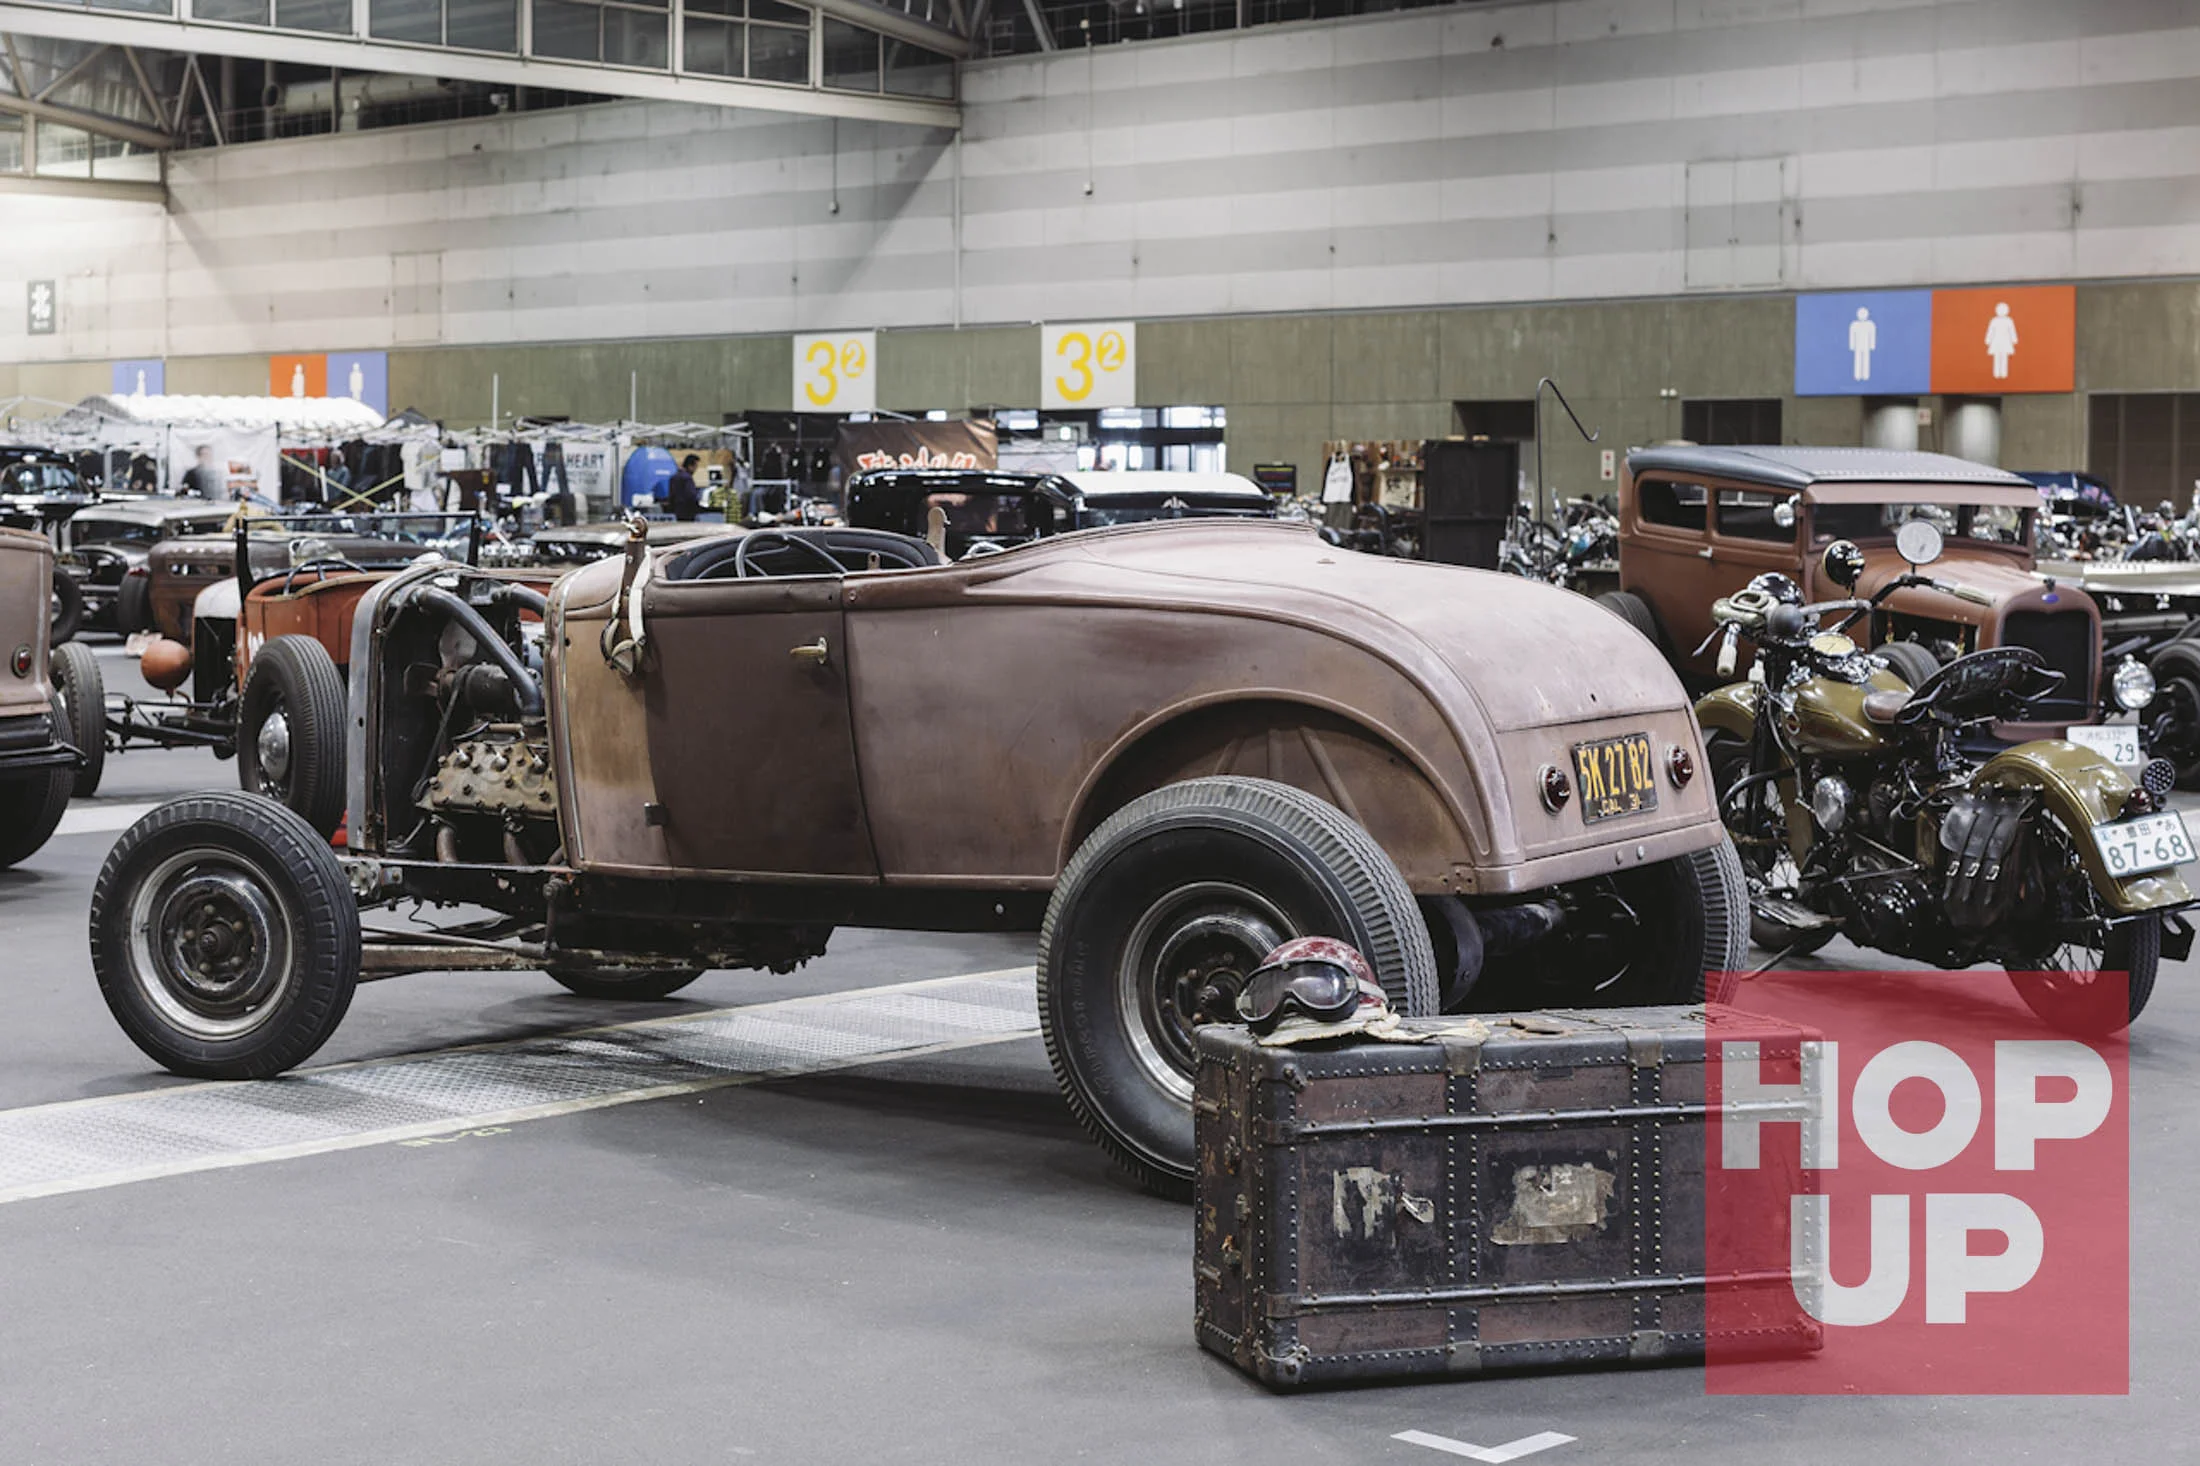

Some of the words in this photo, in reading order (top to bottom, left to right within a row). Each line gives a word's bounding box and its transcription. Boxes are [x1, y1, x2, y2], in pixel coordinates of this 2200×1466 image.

[1578, 748, 1606, 800] 5K
[1605, 743, 1627, 795] 27
[1629, 739, 1653, 790] 82
[2108, 834, 2187, 870] 87-68
